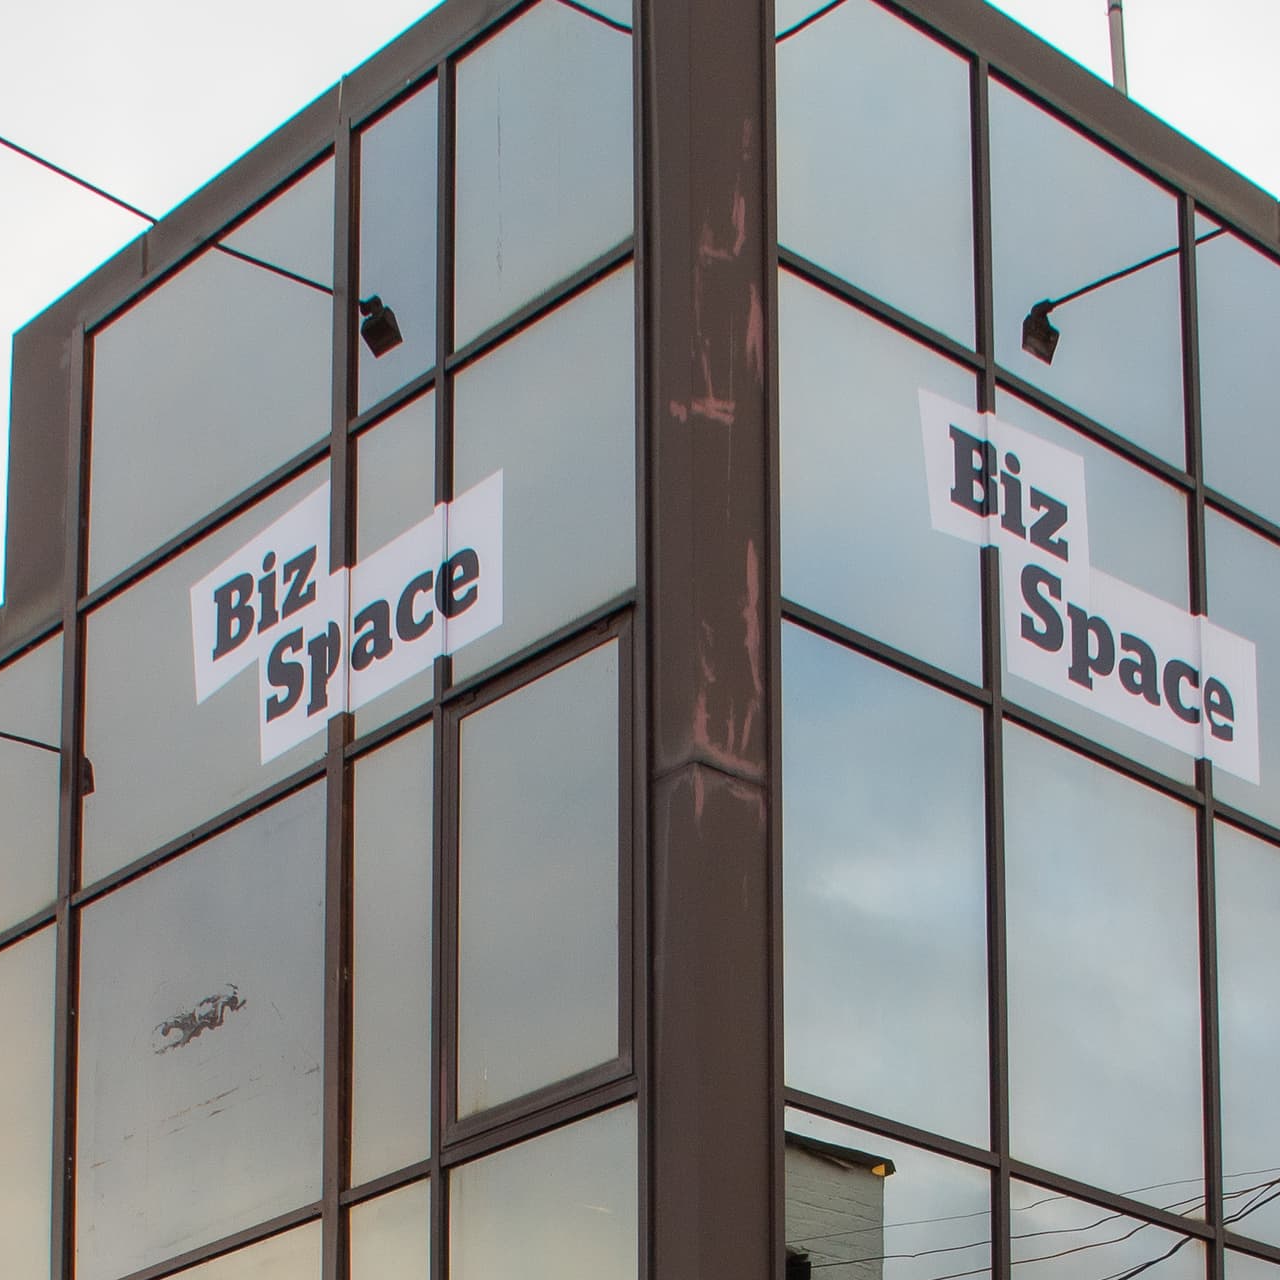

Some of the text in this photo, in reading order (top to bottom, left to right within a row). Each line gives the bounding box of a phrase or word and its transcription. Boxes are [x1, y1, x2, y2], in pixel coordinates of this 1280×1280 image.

[948, 423, 1070, 562] Biz
[212, 544, 318, 662] Biz
[265, 547, 481, 723] Space
[1020, 563, 1235, 742] Space
